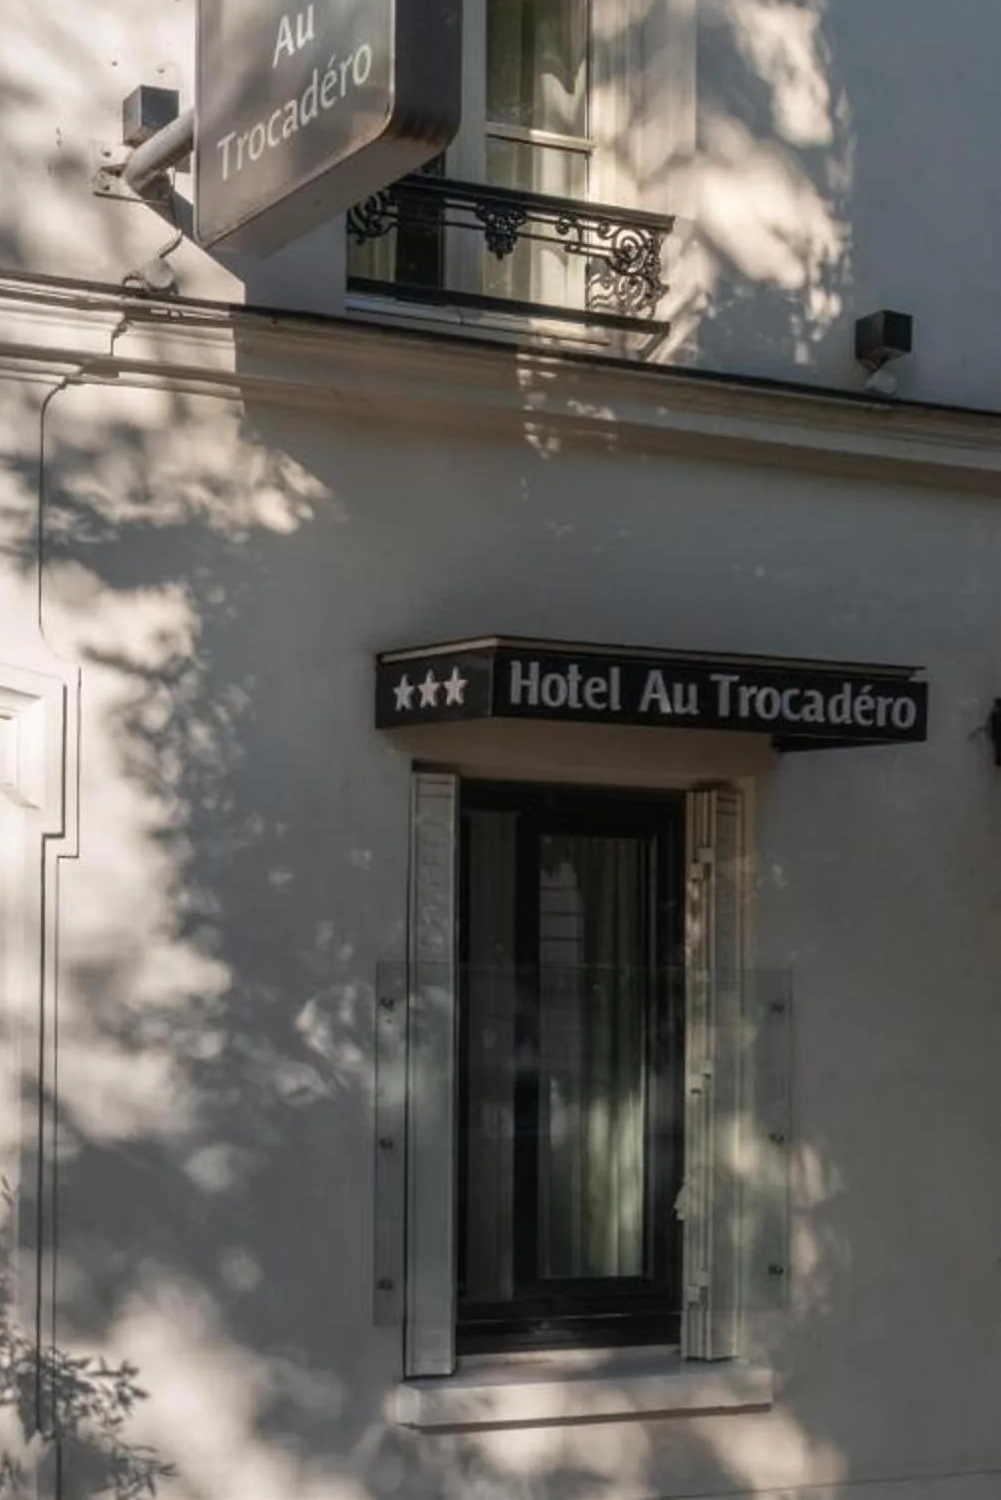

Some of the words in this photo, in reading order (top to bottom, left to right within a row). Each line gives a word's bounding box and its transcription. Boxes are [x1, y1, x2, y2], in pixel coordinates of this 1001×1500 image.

[272, 3, 315, 69] Au
[216, 42, 373, 182] Trocadéro
[509, 659, 621, 712] Hotel
[638, 669, 698, 716] Au
[710, 672, 918, 730] Trocadéro
